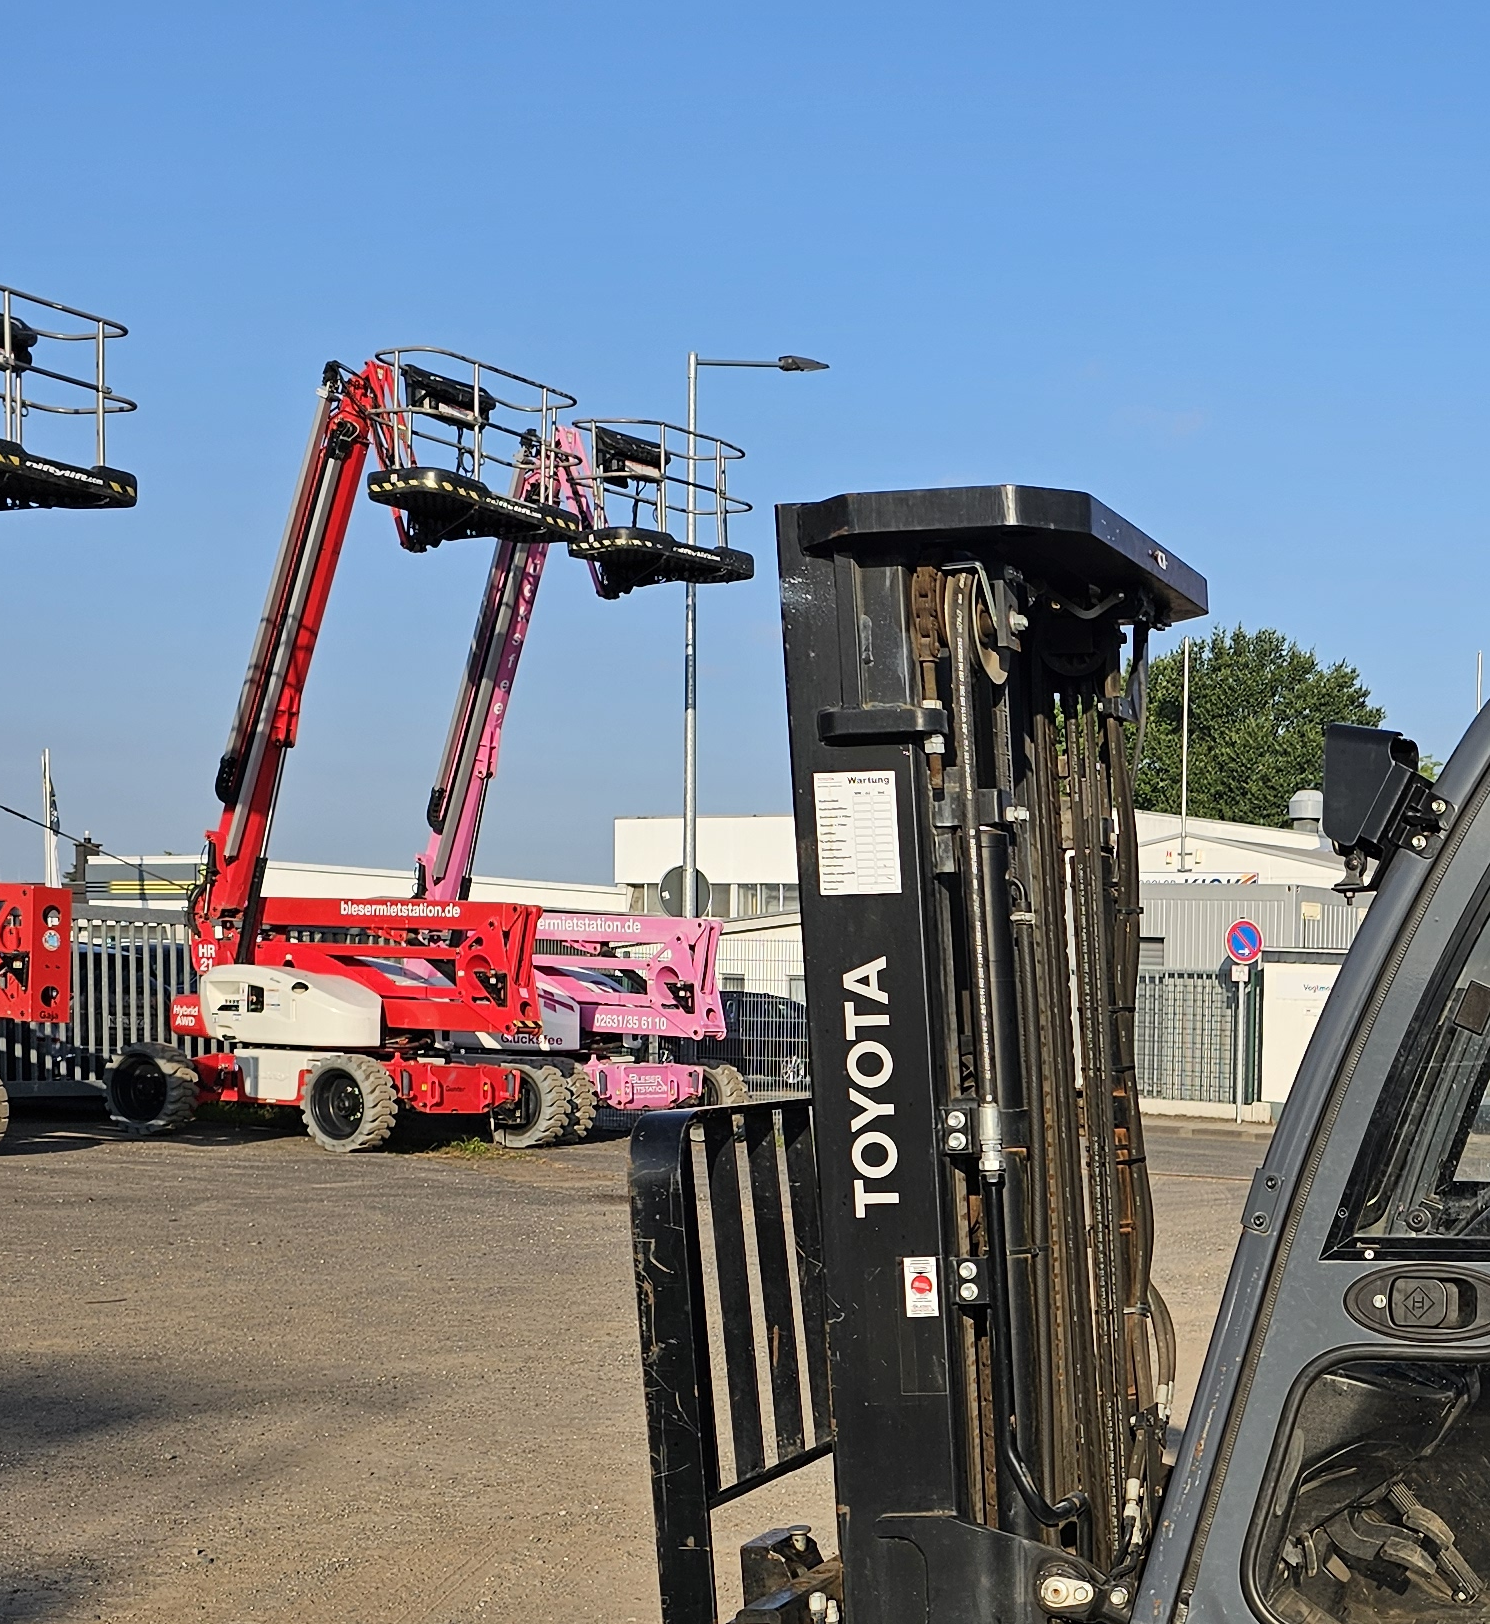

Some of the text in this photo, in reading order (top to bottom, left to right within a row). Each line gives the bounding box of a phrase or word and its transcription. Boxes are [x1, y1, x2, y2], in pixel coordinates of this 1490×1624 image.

[847, 776, 890, 785] Wartung
[340, 901, 460, 918] blesermietstation.de
[198, 944, 216, 958] HR
[200, 958, 213, 971] 21
[39, 1010, 58, 1021] Gaja
[173, 1004, 199, 1017] Hybrid
[175, 1016, 195, 1027] AWD
[594, 1013, 667, 1030] 02631/35 61 10
[842, 955, 900, 1219] TOYOTA
